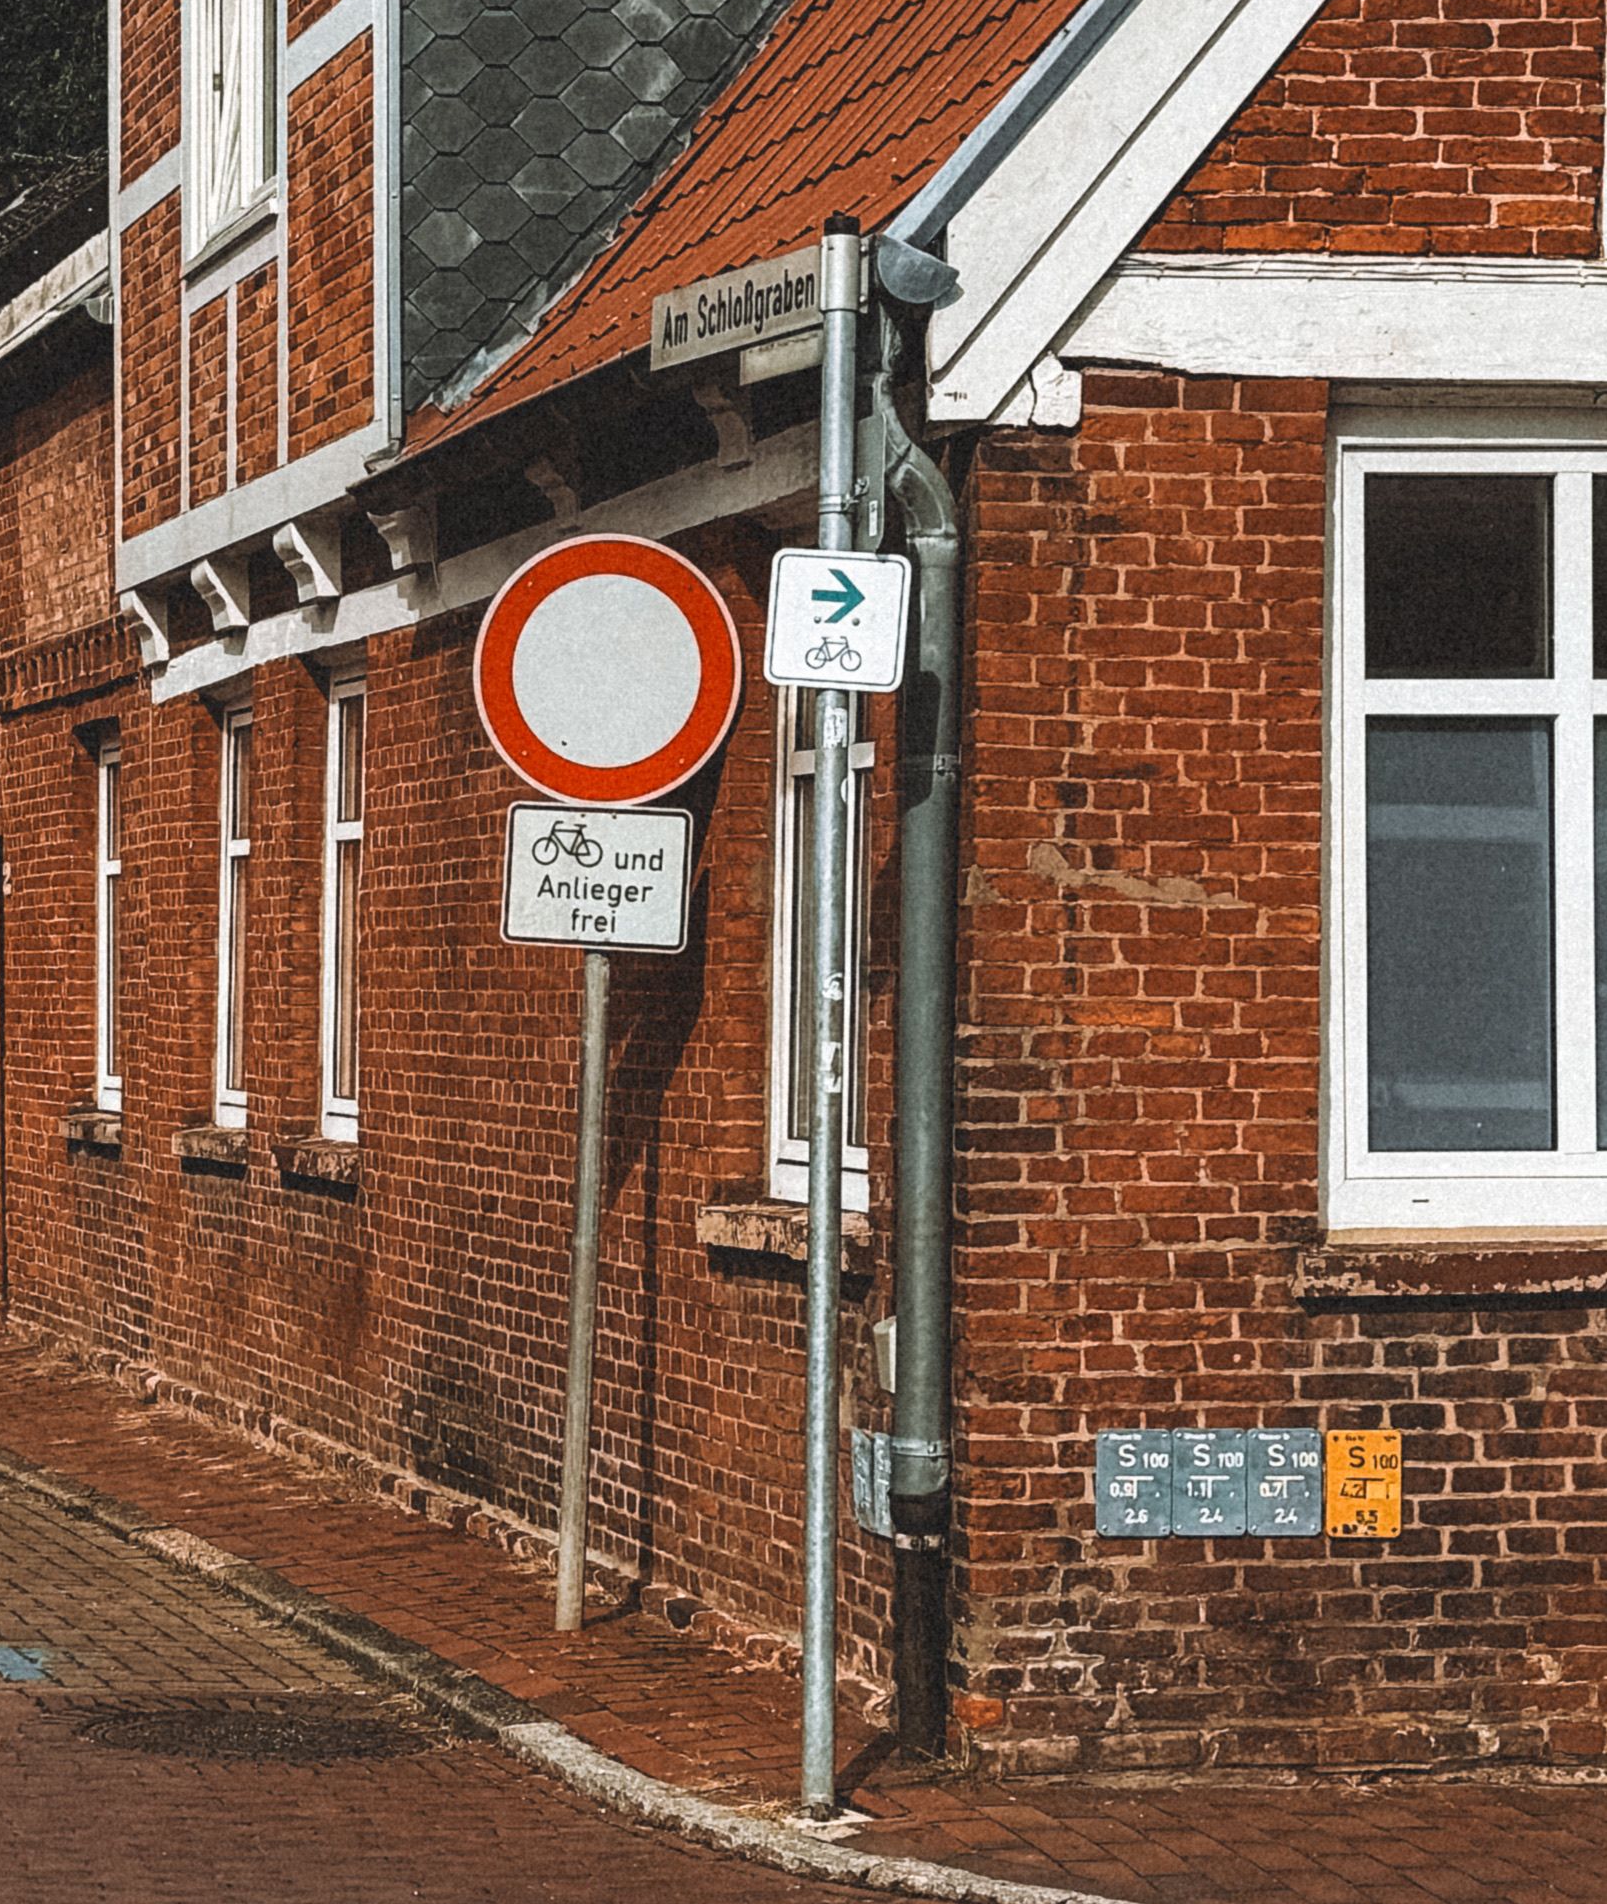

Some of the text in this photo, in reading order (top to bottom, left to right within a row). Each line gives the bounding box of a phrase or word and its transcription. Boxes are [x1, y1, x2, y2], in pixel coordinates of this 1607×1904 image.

[662, 306, 689, 349] Am
[697, 269, 816, 339] Schloßgraben
[615, 848, 664, 872] und
[537, 874, 654, 908] Anlieger
[571, 908, 616, 933] frei
[1118, 1443, 1169, 1469] S 100
[1193, 1443, 1244, 1468] S 100
[1267, 1443, 1318, 1468] S 100
[1348, 1445, 1398, 1470] S 100
